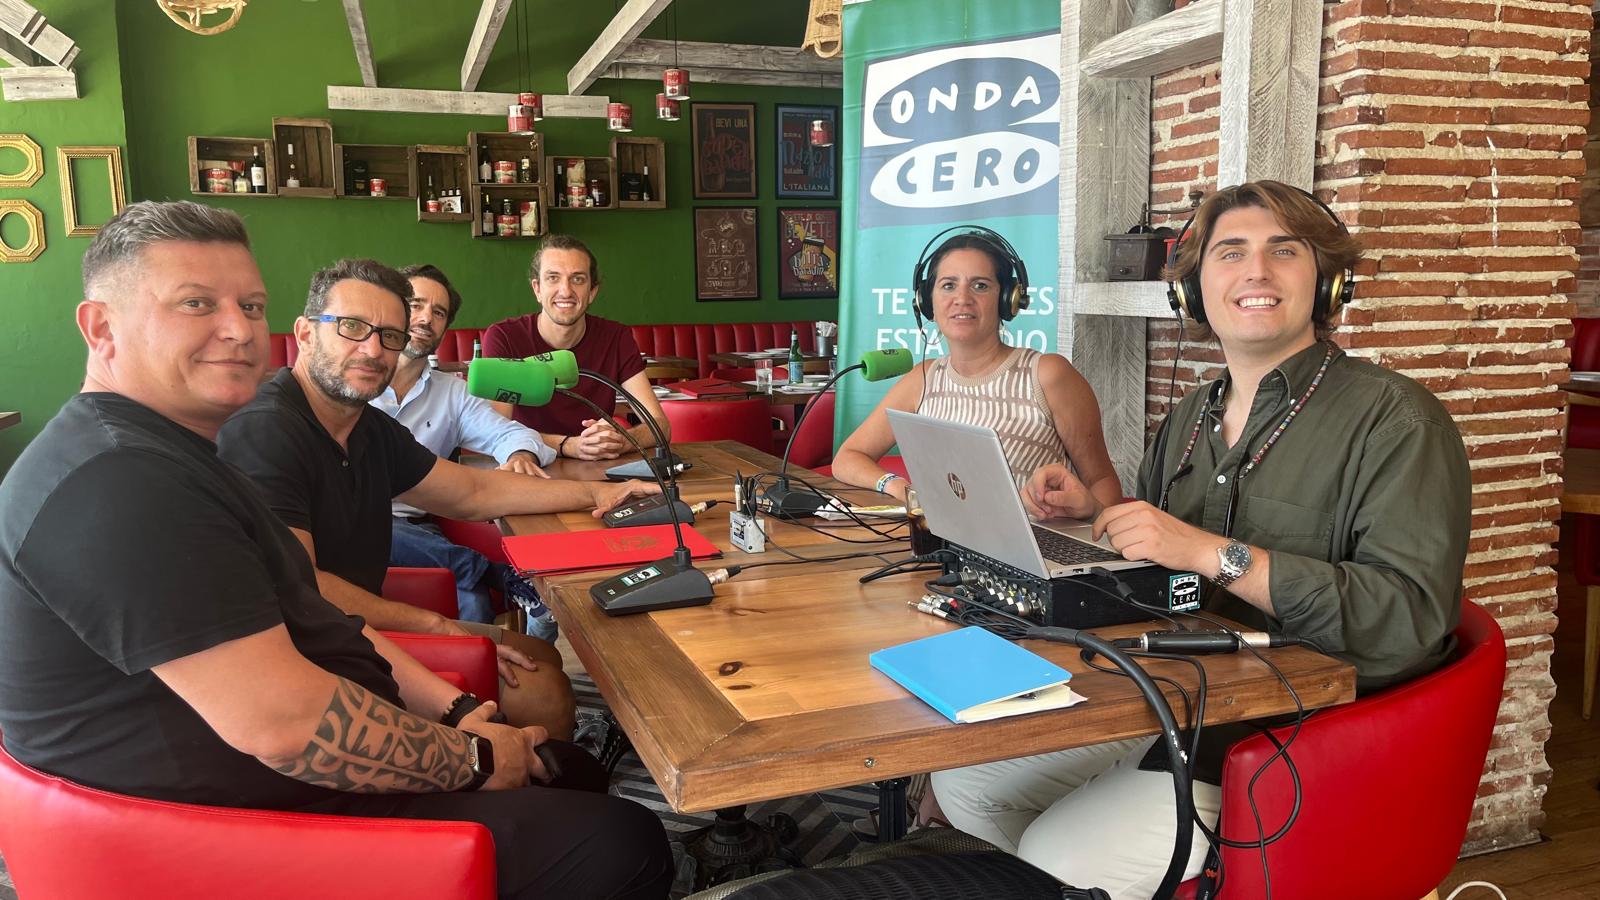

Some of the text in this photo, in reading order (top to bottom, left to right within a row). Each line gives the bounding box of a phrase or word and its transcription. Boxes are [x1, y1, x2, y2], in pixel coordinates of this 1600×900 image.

[890, 75, 1041, 124] ONDA
[896, 147, 1040, 194] CERO
[783, 183, 829, 191] L'ITALIANA
[872, 288, 908, 315] TE
[877, 328, 944, 355] ESTA
[1173, 594, 1196, 604] CERO
